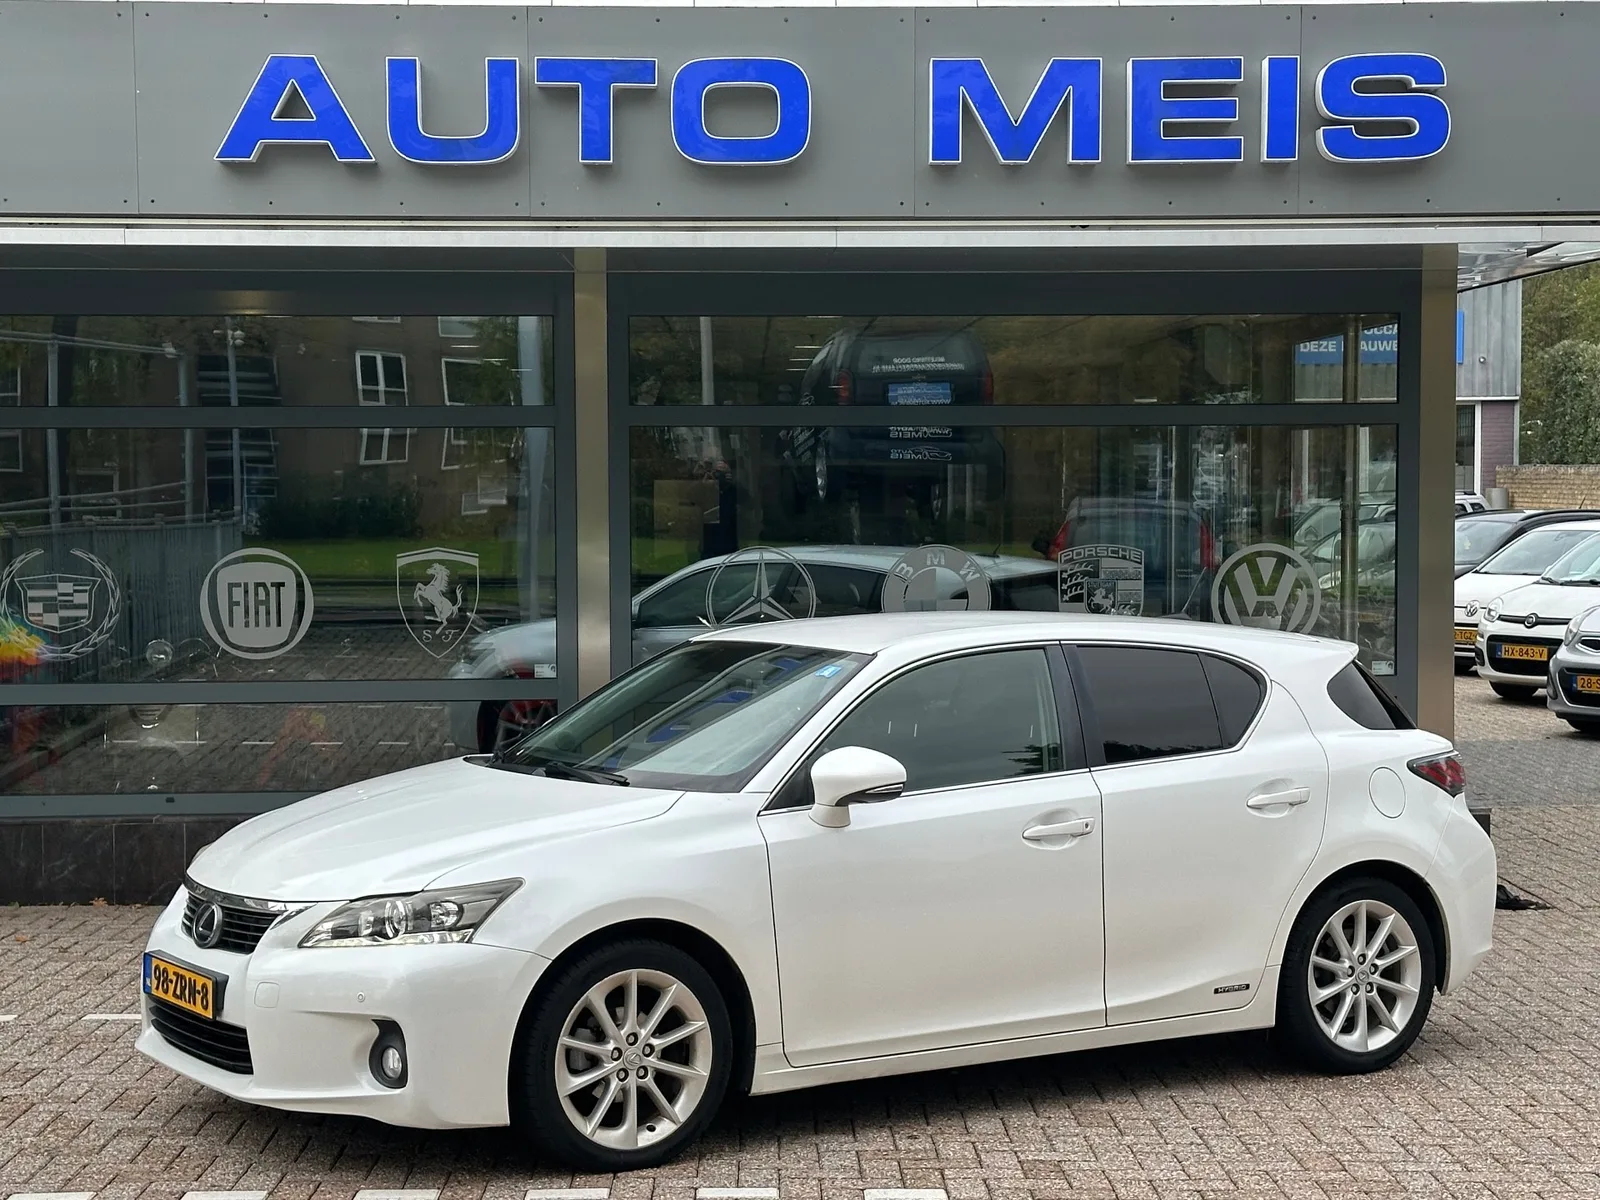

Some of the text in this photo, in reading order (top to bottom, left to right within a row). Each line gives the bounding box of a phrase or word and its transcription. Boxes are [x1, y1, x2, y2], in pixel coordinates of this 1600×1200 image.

[213, 52, 1452, 166] AUTO MEIS
[1299, 340, 1398, 352] DEZE AUWE
[1061, 546, 1142, 564] PORSCHE
[227, 581, 286, 628] FIAT
[1503, 646, 1544, 659] HX-843-V
[1580, 678, 1600, 689] 28-S
[153, 964, 209, 1011] 98-ZRN-8
[1217, 984, 1248, 993] HYBRID
